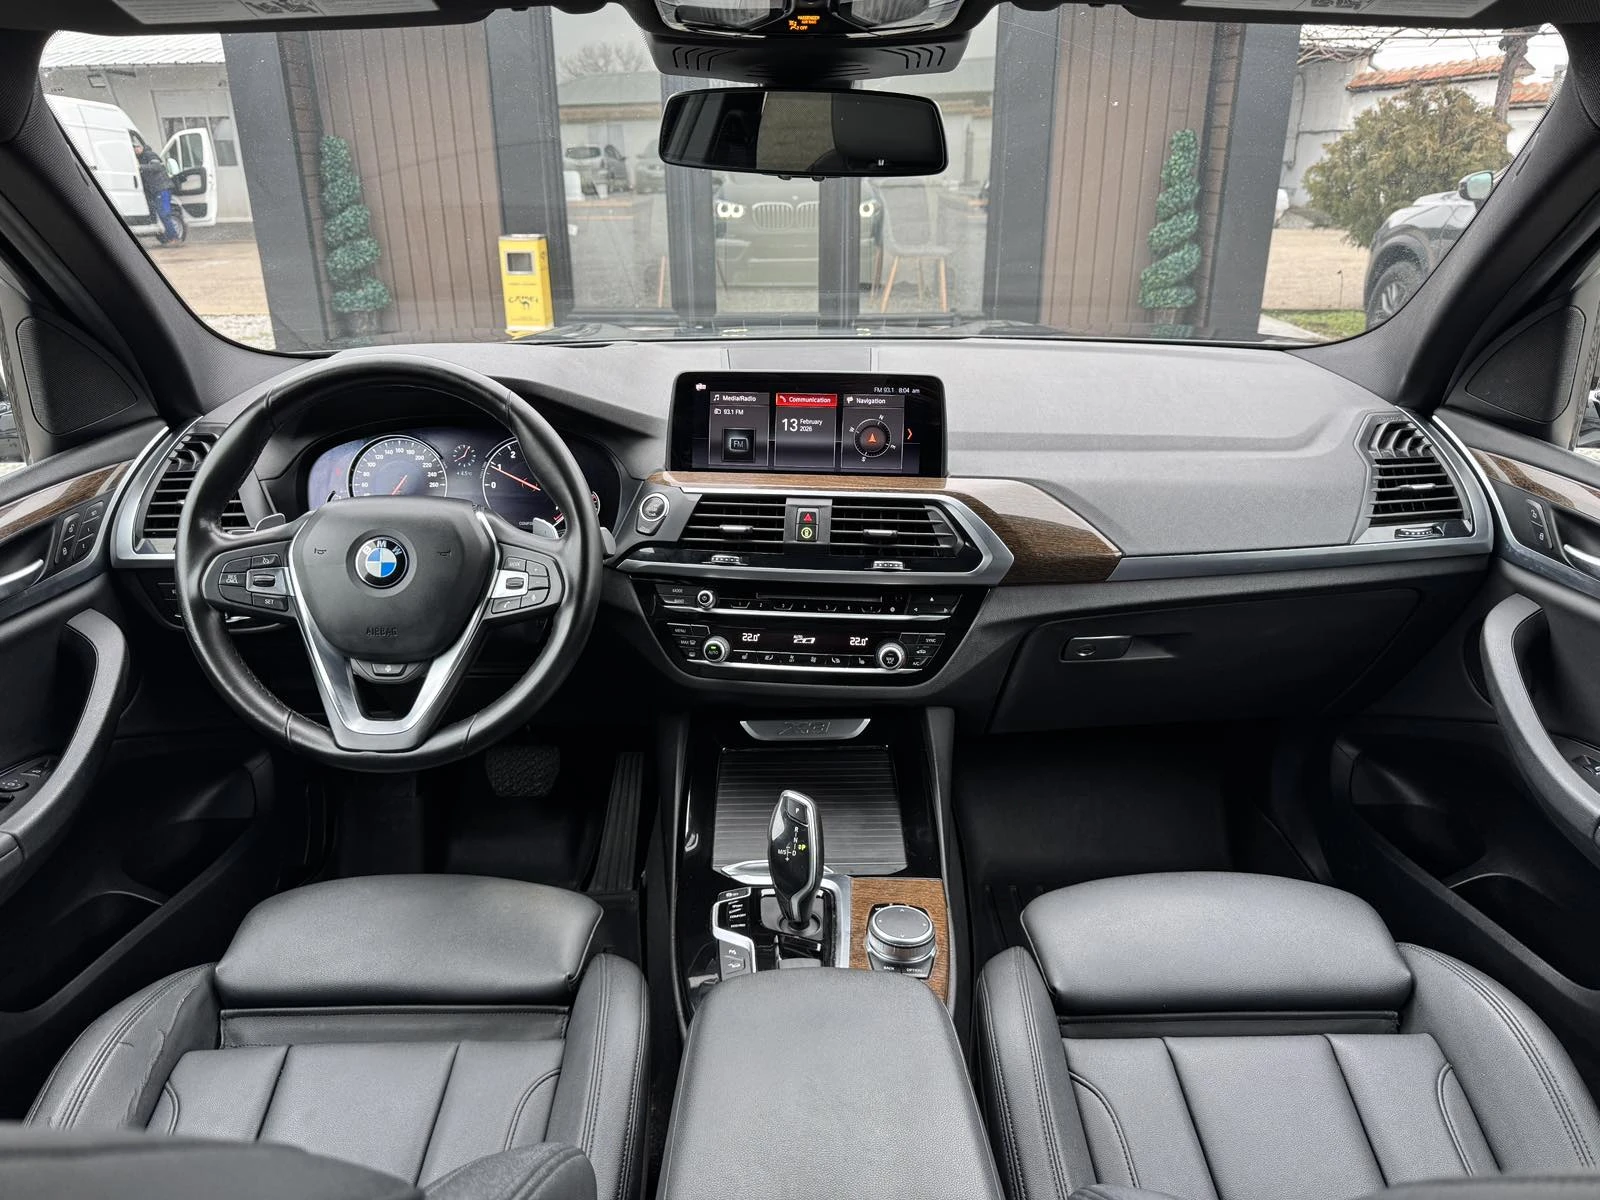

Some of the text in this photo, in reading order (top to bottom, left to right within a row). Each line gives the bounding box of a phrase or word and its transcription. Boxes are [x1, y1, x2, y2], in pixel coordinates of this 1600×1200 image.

[856, 397, 886, 405] Navigation
[782, 418, 798, 432] 13
[799, 418, 823, 426] February
[733, 440, 744, 448] FM
[510, 451, 517, 459] 2
[490, 481, 497, 489] 0
[362, 540, 403, 556] BMW
[365, 626, 399, 637] AIRBAG
